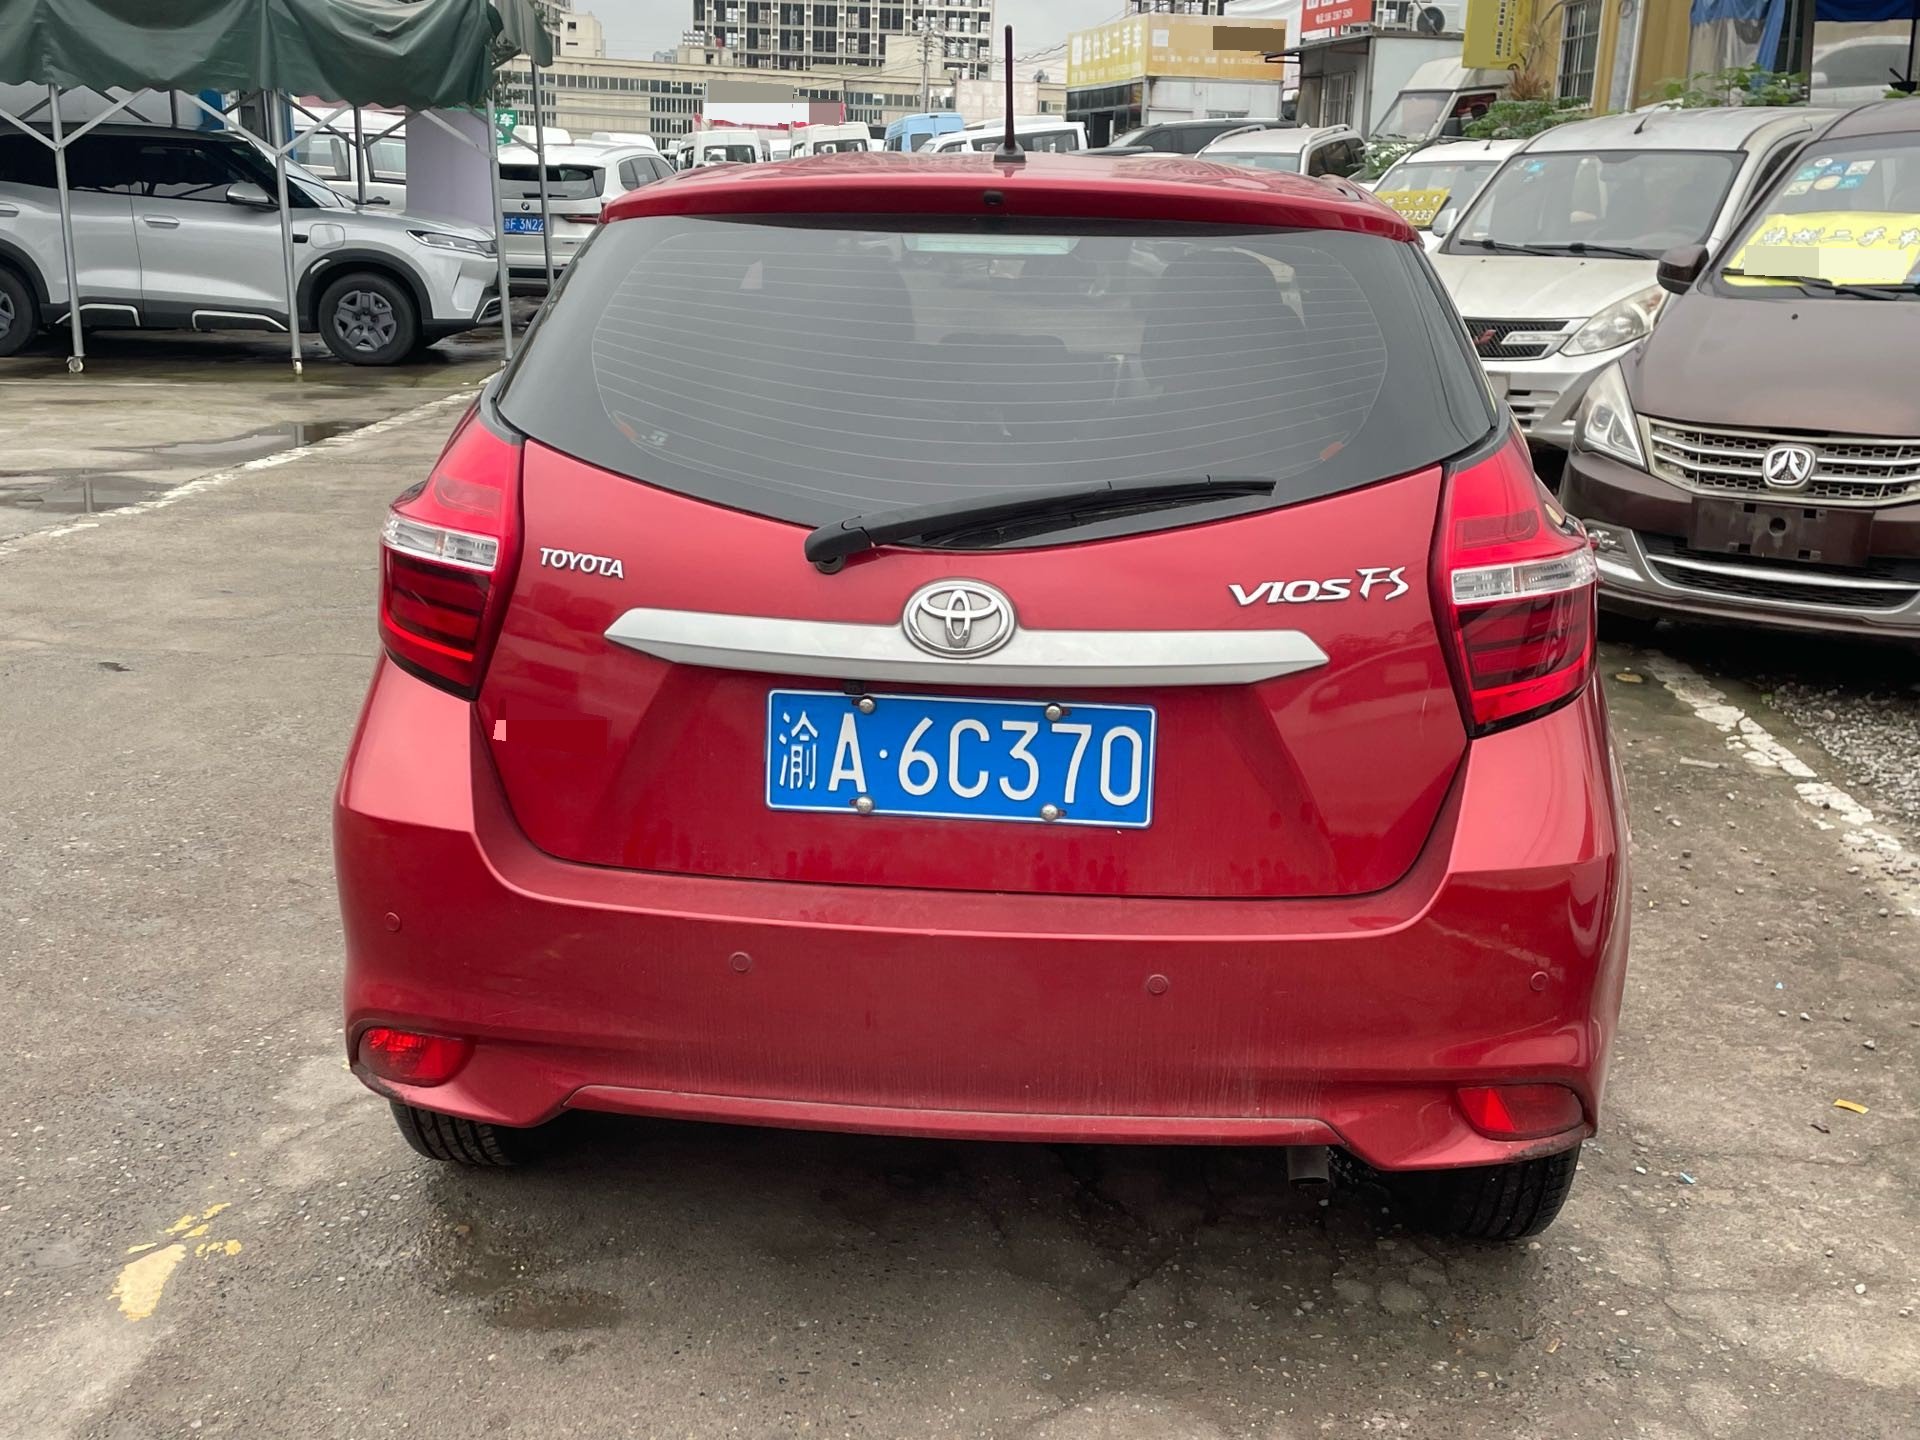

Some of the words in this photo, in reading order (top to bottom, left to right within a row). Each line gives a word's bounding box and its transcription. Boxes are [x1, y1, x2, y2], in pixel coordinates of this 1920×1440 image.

[540, 547, 624, 579] TOYOTA
[1228, 578, 1352, 606] VIOS
[1355, 566, 1409, 601] FS
